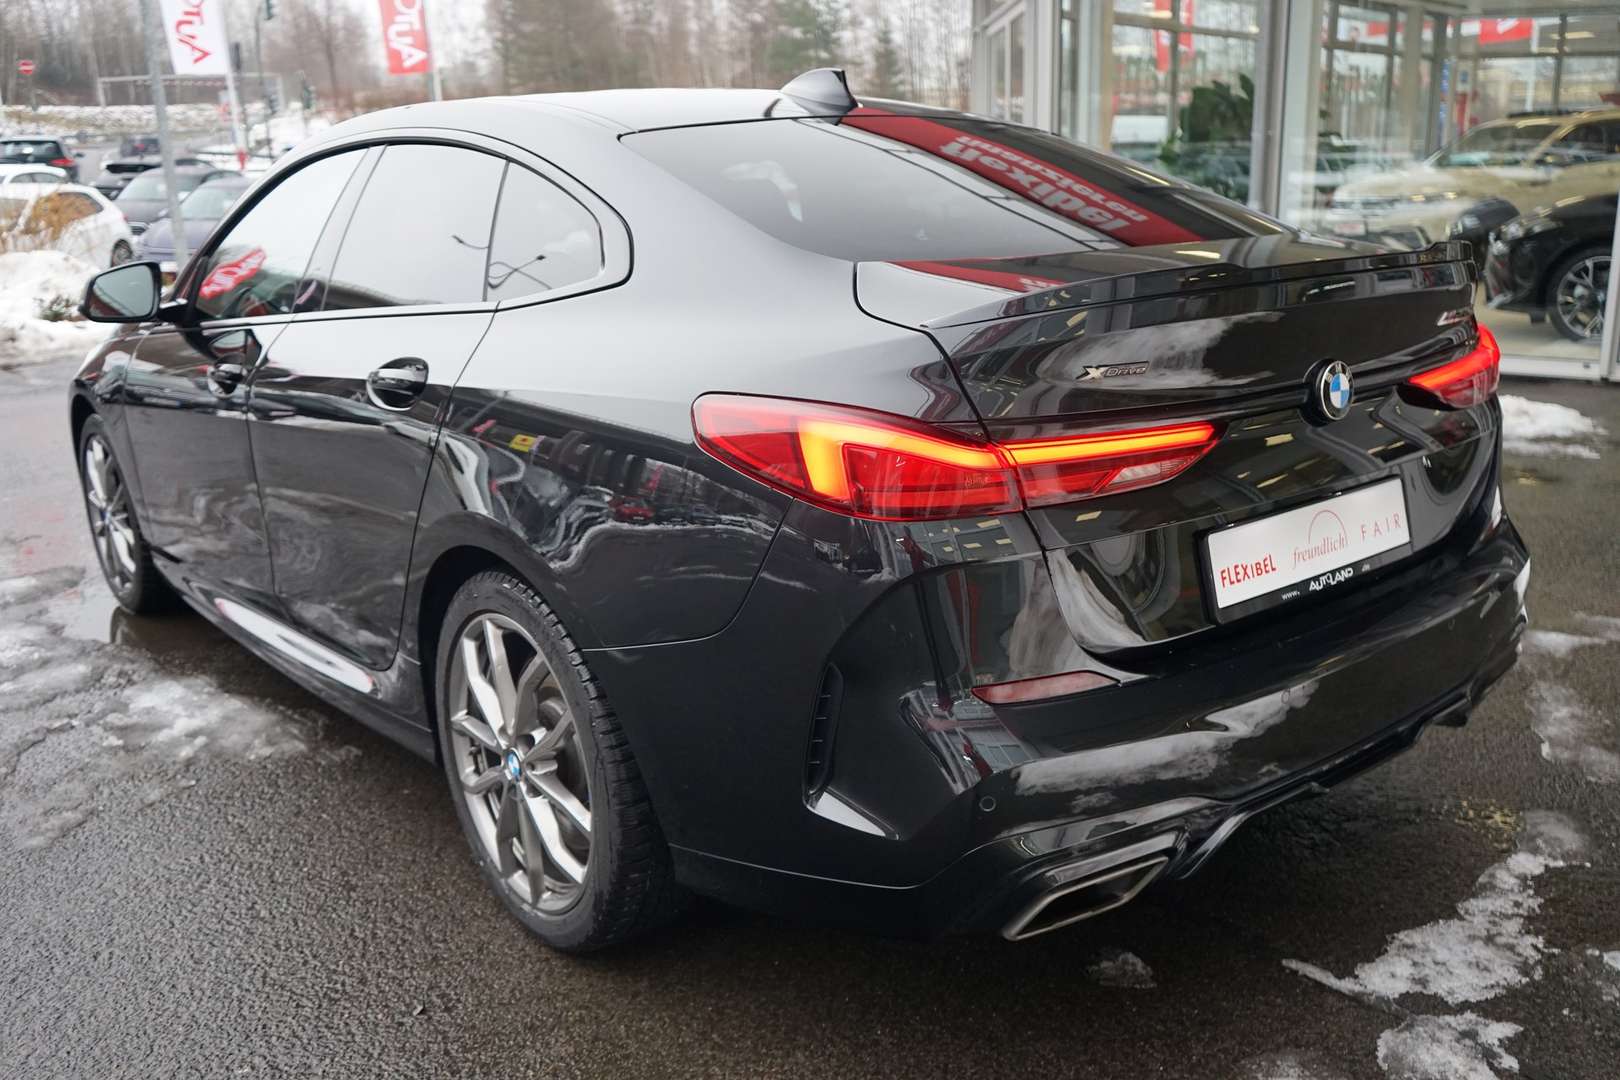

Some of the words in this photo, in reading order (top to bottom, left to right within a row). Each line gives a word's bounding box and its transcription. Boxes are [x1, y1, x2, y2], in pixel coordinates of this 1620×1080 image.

[1220, 554, 1276, 588] FLEXIBEL
[1291, 533, 1345, 570] freundlich
[1360, 513, 1402, 541] FAIR
[1308, 567, 1354, 591] AUTOLAND
